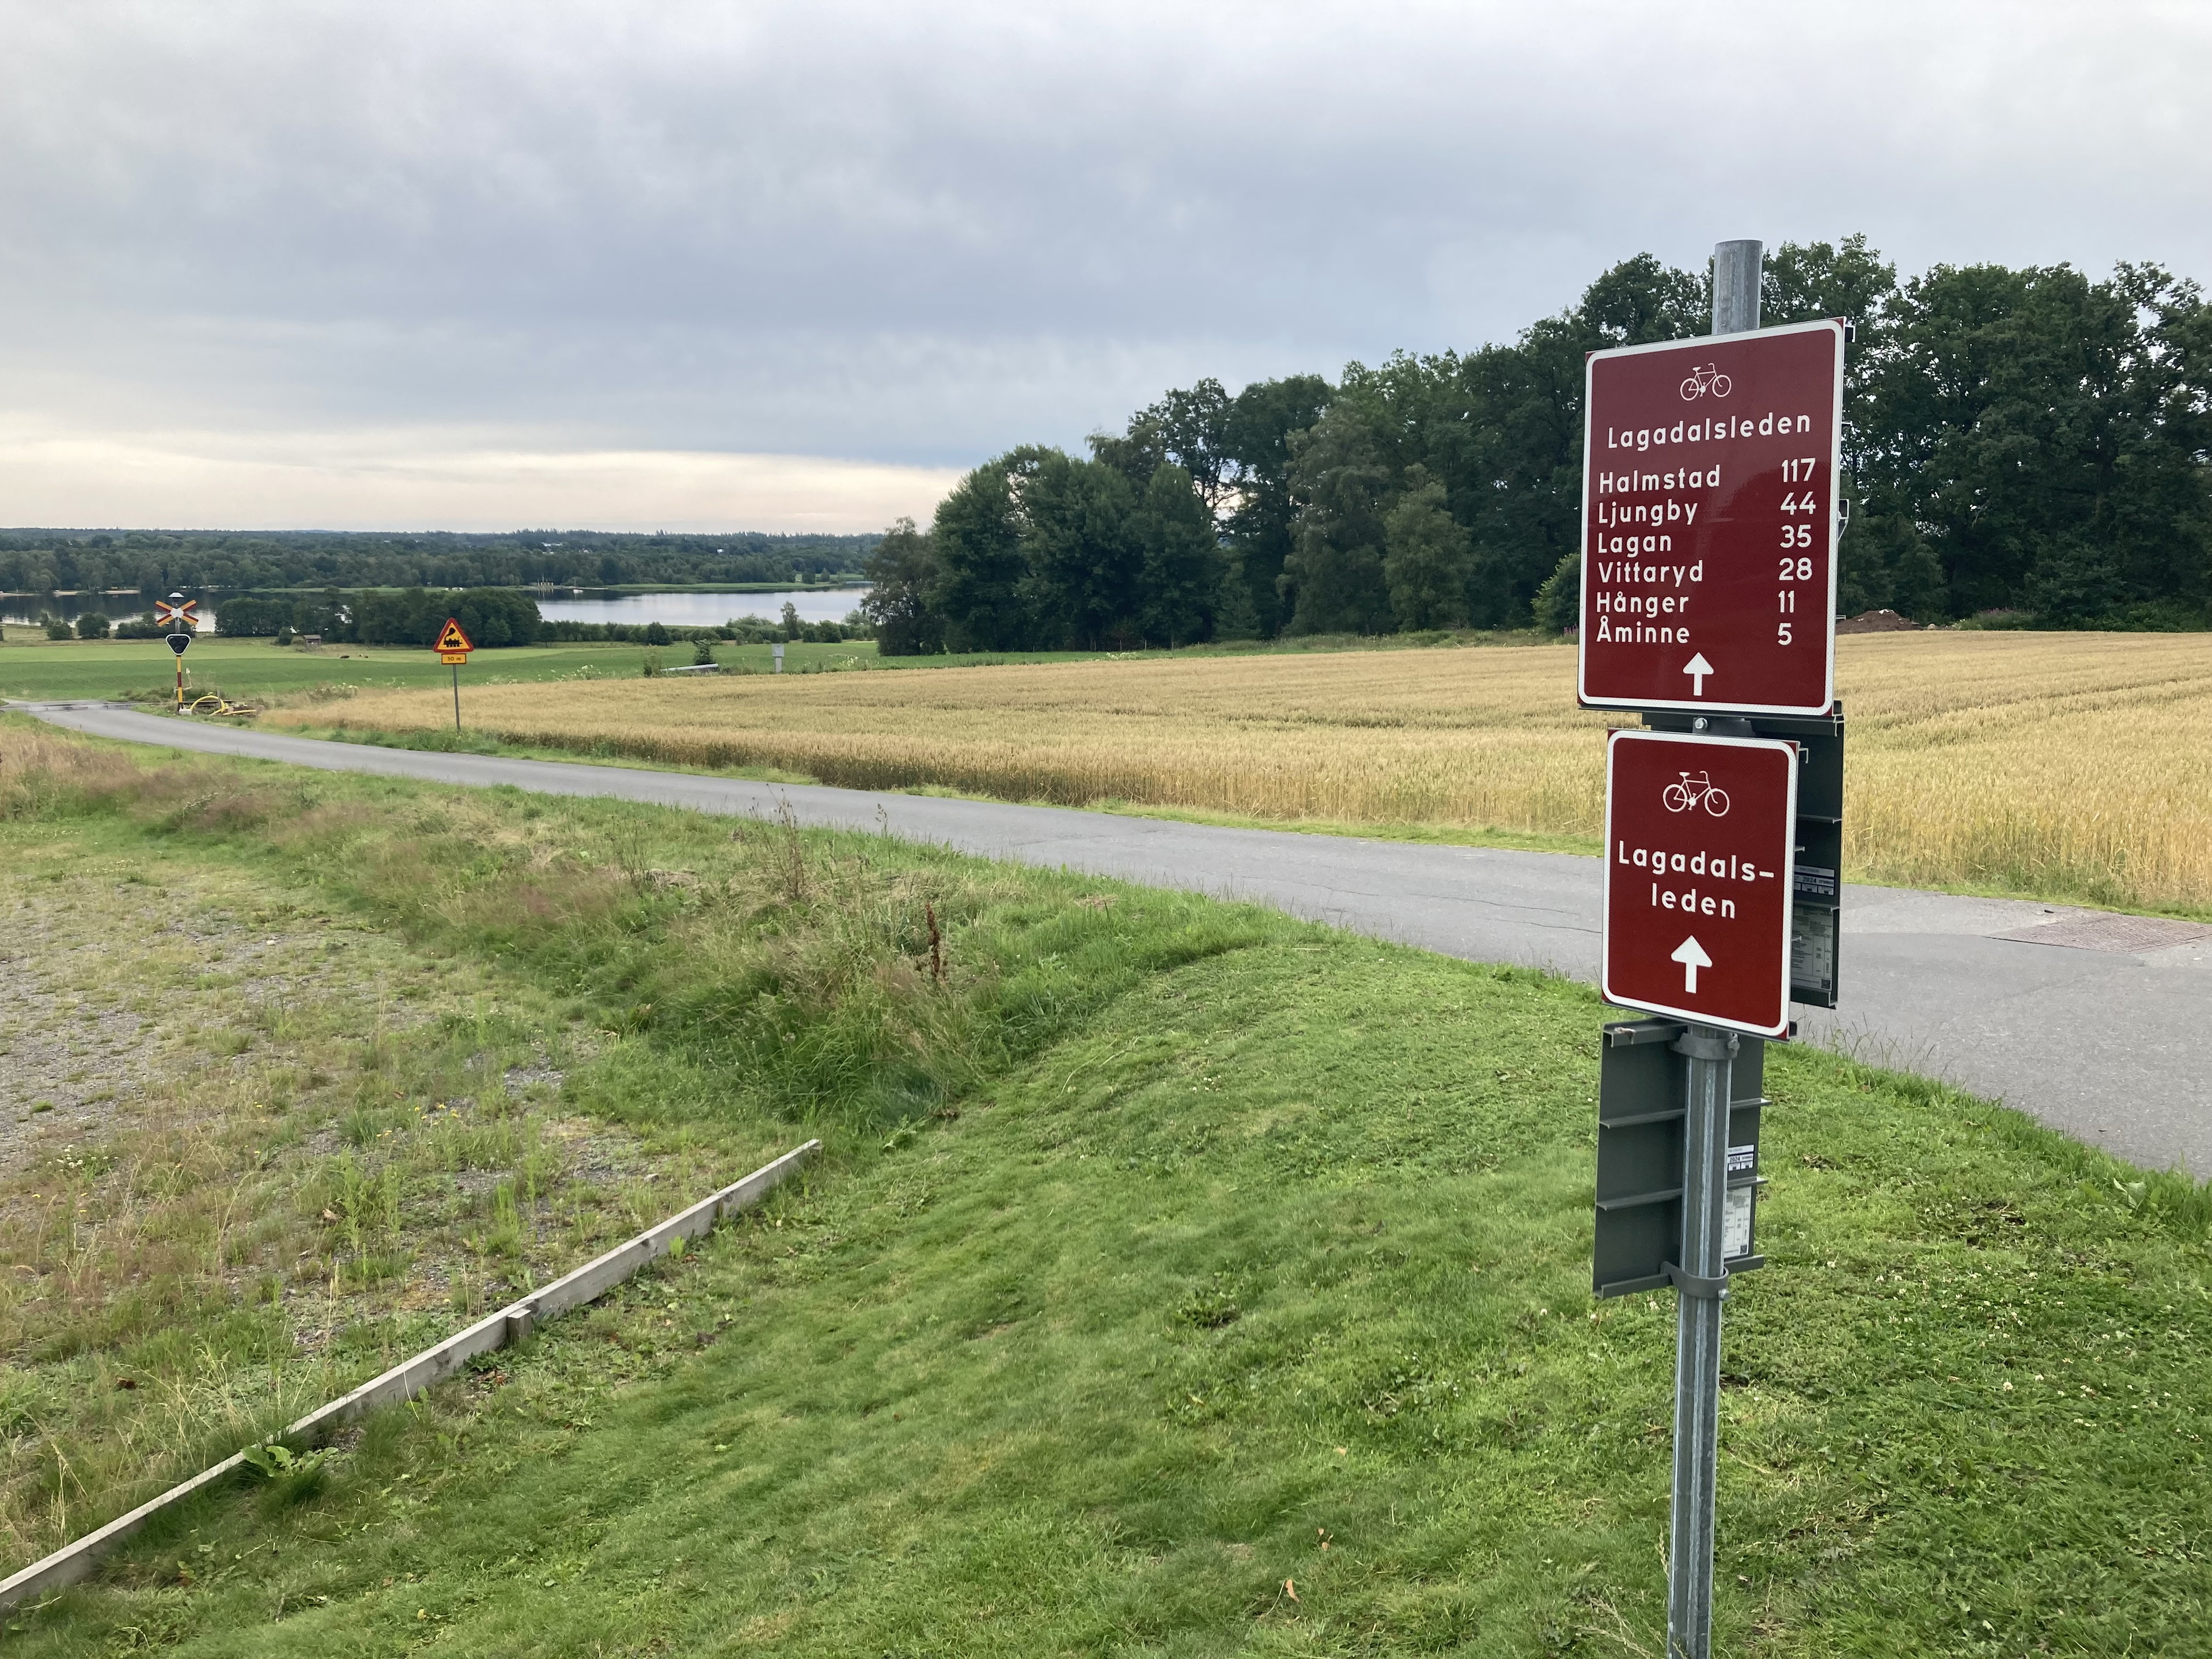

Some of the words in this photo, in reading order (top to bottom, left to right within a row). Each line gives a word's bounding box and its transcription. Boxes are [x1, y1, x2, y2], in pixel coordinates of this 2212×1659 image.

[1608, 412, 1810, 452] Lagadalsleden
[1599, 464, 1720, 494] Halmstad
[1781, 457, 1816, 483] 117
[1599, 498, 1698, 528] Ljungby
[1780, 491, 1816, 516] 44
[1598, 532, 1671, 558] Lagan
[1779, 524, 1812, 548] 35
[1598, 559, 1703, 588] Vittaryd
[1779, 557, 1813, 581] 28
[1596, 590, 1689, 618] Hånger
[1778, 590, 1794, 613] 11
[1596, 615, 1690, 643] Åminne
[1777, 623, 1792, 646] 5
[1619, 840, 1774, 881] Lagadals-
[1652, 882, 1735, 919] leden
